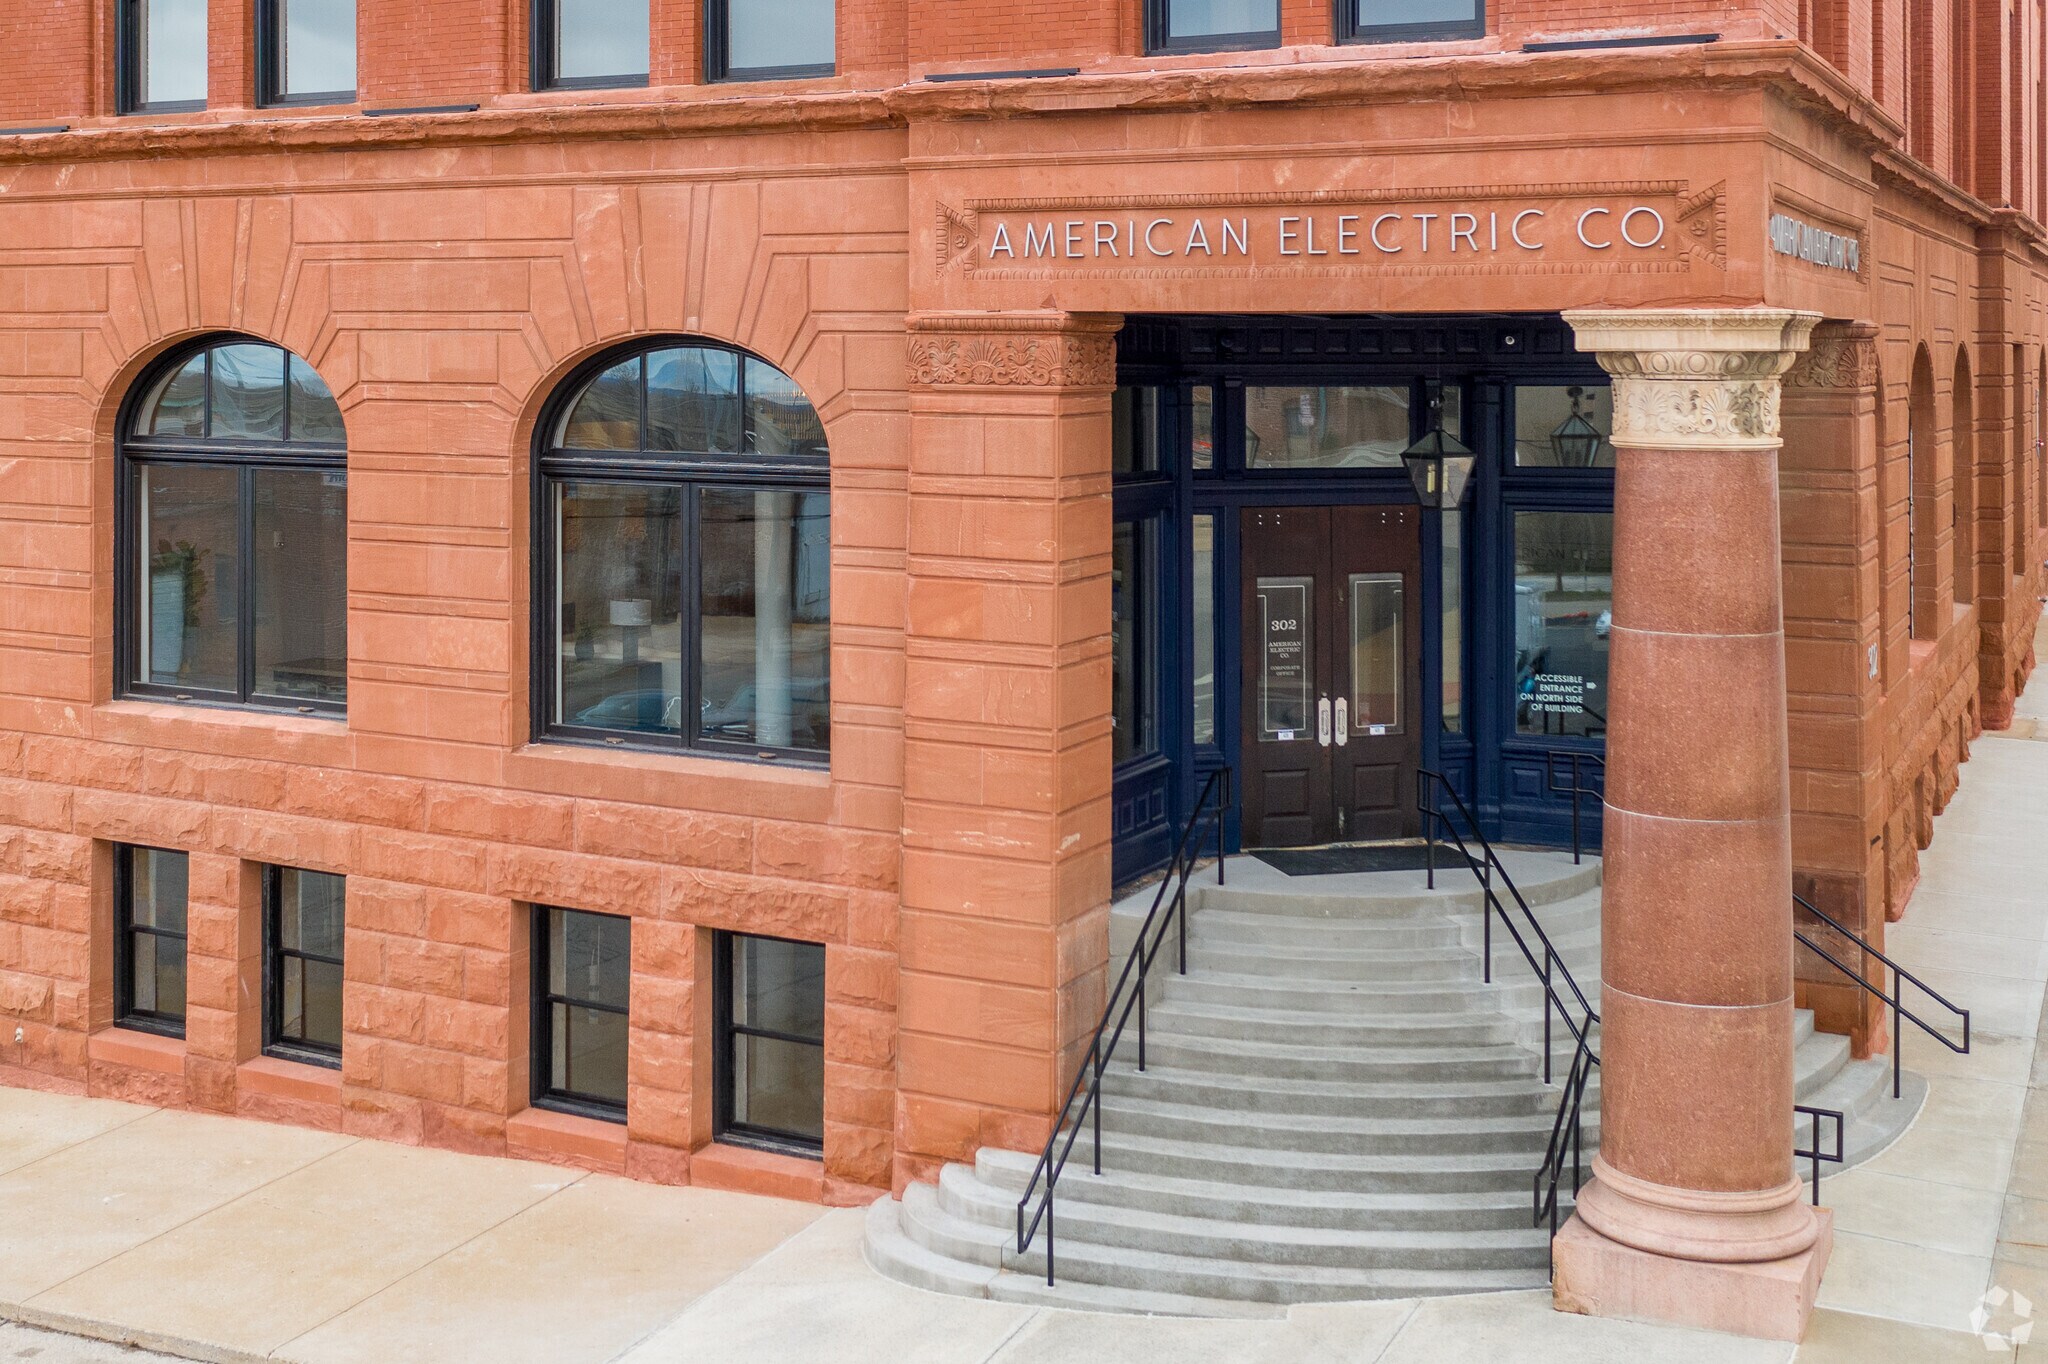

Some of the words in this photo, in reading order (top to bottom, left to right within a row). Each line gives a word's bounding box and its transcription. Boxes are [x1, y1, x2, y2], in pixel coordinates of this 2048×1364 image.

[989, 218, 1249, 259] AMERICAN
[1278, 209, 1544, 256] ELECTRIC
[1575, 206, 1667, 251] CO.
[1271, 619, 1297, 631] 302
[1534, 673, 1583, 684] ACCESSIBLE
[1540, 683, 1583, 693] ENTRANCE
[1520, 692, 1534, 700] ON
[1535, 693, 1563, 702] NORTH
[1565, 695, 1583, 703] SIDE
[1531, 703, 1543, 711] OF
[1544, 703, 1583, 714] BUILDING
